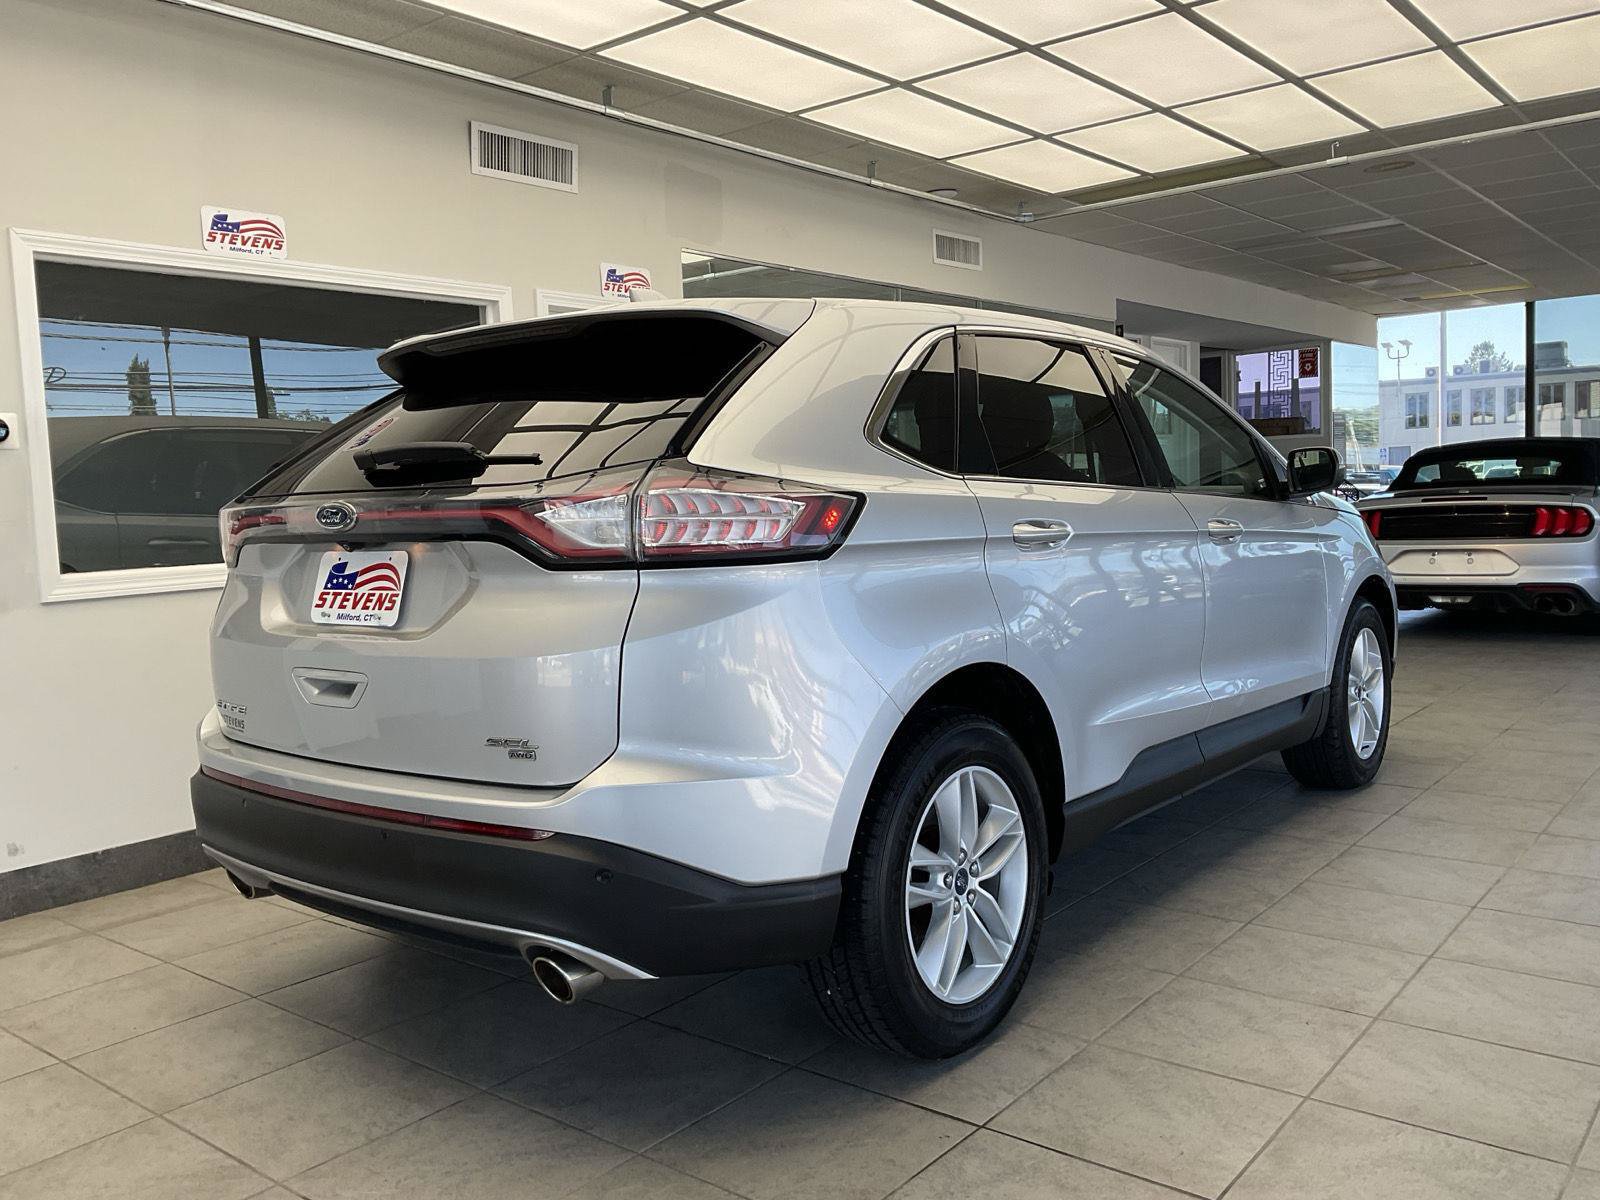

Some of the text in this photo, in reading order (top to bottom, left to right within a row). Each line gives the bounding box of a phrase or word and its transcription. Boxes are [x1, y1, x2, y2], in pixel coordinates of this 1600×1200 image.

[206, 231, 285, 251] STEVENS
[229, 246, 254, 255] Milford,
[321, 508, 342, 523] Ford
[314, 591, 400, 611] STEVENS
[336, 612, 374, 622] Milford, CT
[484, 738, 539, 750] SEL
